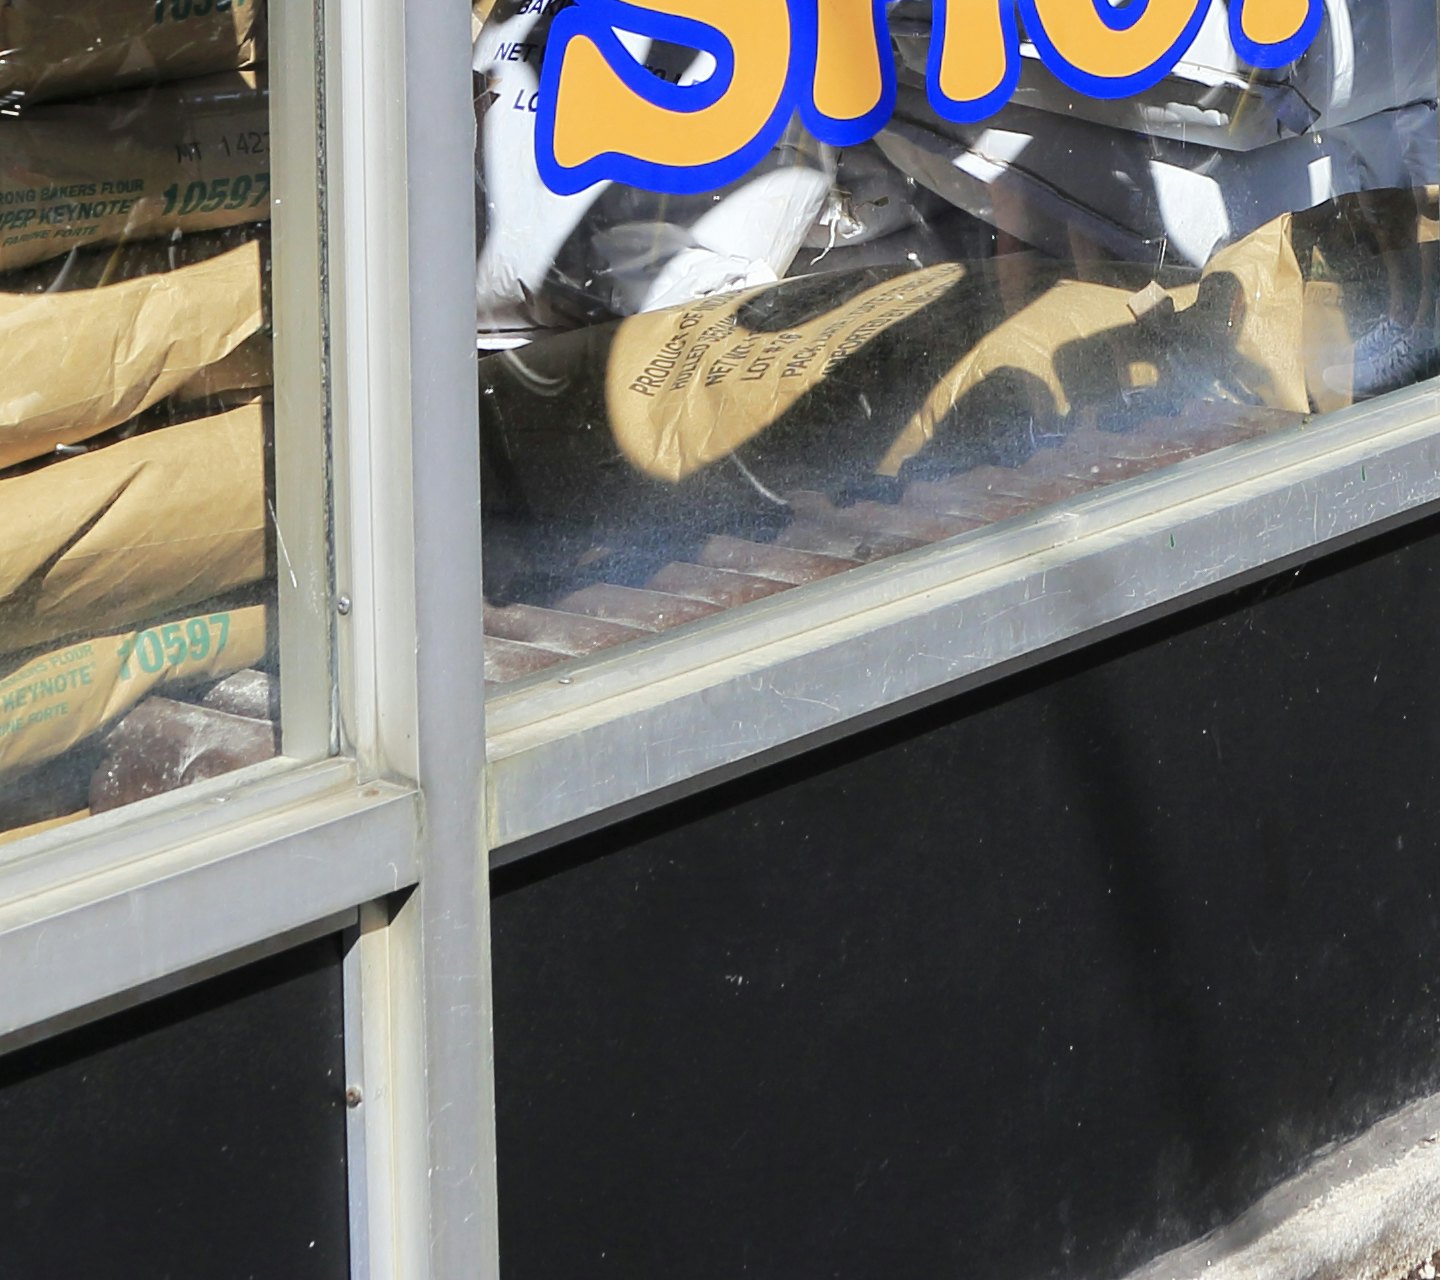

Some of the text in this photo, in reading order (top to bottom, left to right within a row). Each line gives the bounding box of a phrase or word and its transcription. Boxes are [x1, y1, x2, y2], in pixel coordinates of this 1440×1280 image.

[40, 181, 98, 202] BAKERS
[101, 177, 146, 196] FLOUR
[161, 172, 272, 218] 10597
[39, 196, 133, 226] KEYNOTE
